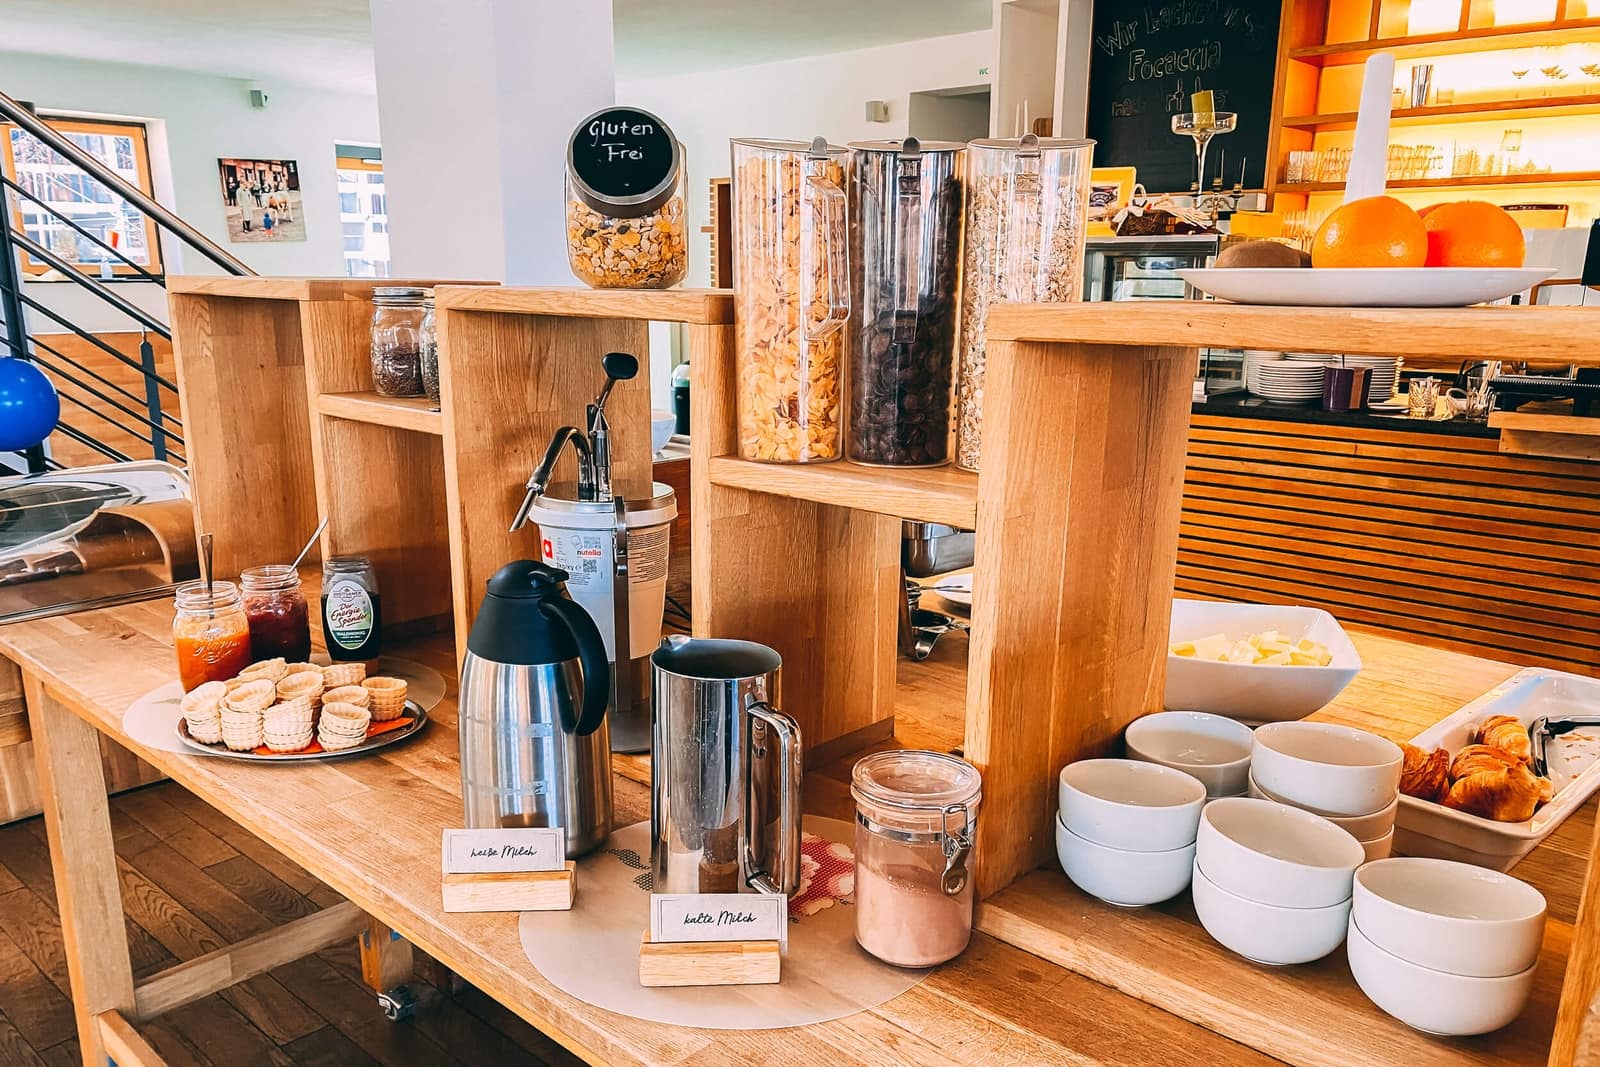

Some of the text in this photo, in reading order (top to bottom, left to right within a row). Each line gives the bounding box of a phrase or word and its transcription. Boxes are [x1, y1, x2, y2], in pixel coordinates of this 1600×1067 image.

[1096, 20, 1138, 56] Wir
[1128, 40, 1222, 82] Focaccia
[588, 120, 653, 147] Gluten
[601, 143, 643, 162] Frei
[576, 549, 602, 557] nutella
[331, 607, 362, 621] Energie
[339, 603, 354, 611] Der
[335, 613, 368, 628] Spender
[501, 844, 537, 858] Milch
[684, 910, 757, 925] kalte Milch
